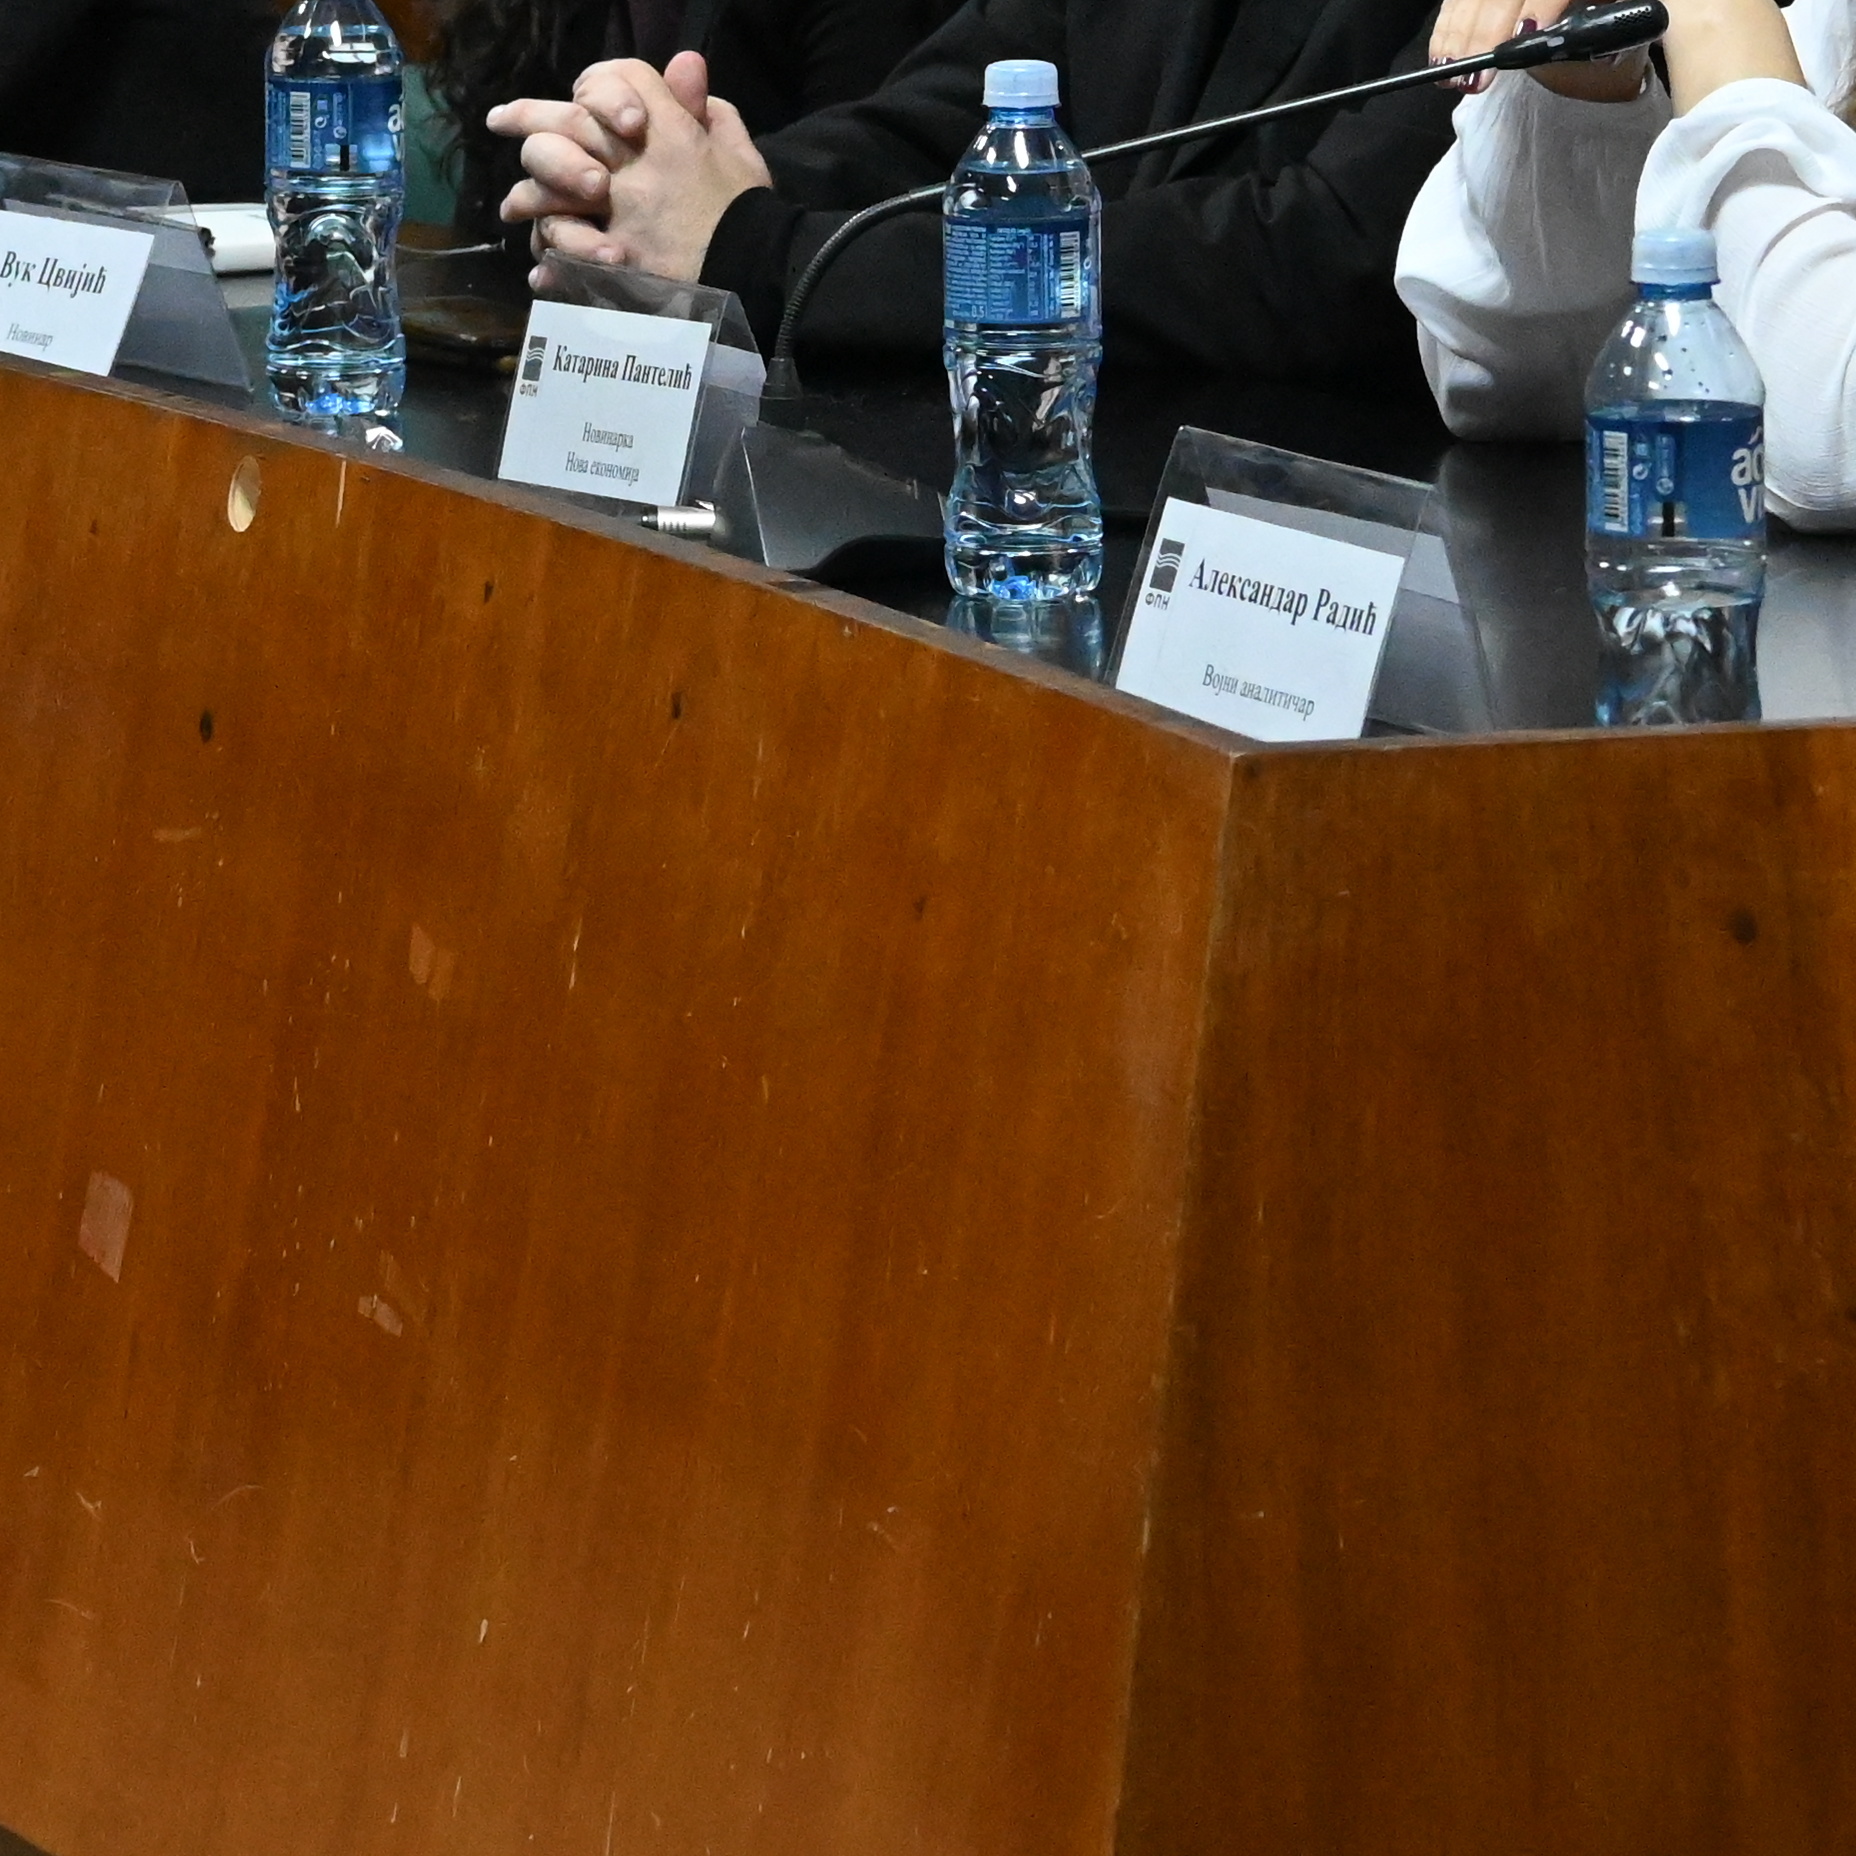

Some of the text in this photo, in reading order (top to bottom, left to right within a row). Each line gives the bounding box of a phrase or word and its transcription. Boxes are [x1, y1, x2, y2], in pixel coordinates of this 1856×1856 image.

[0, 251, 108, 299] Вук Цвијић
[552, 344, 693, 391] Катарина Пантелић
[582, 421, 635, 452] Новинарка
[565, 451, 641, 487] Нова економија
[1145, 592, 1170, 611] ФПН
[1188, 557, 1379, 637] Александар Радић
[1201, 663, 1316, 722] Војни аналитичар
